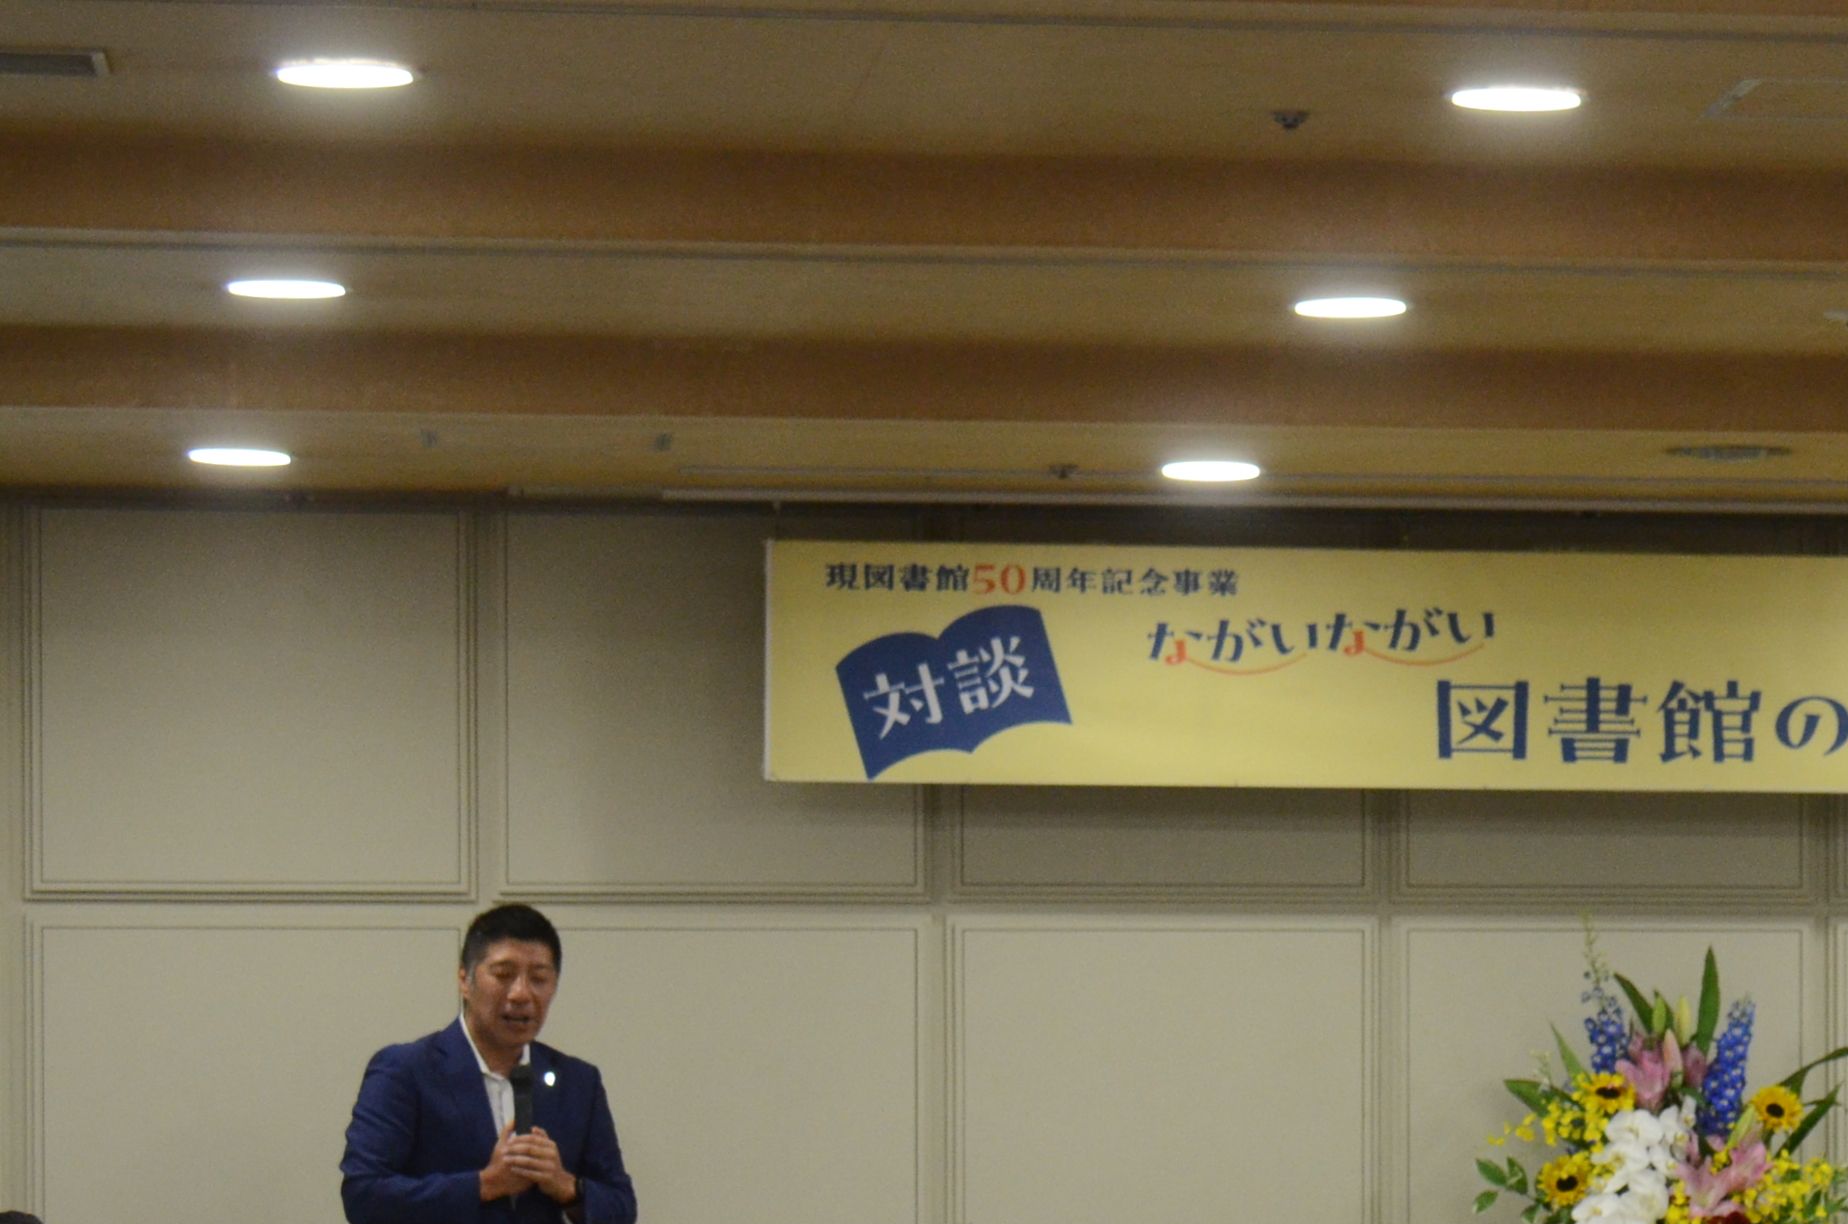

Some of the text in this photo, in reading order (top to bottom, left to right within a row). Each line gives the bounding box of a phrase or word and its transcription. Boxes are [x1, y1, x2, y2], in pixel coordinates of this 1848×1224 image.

[826, 561, 1238, 596] 現図書館50周年記念事業
[1147, 605, 1496, 668] ながいながい
[863, 636, 1035, 740] 対談
